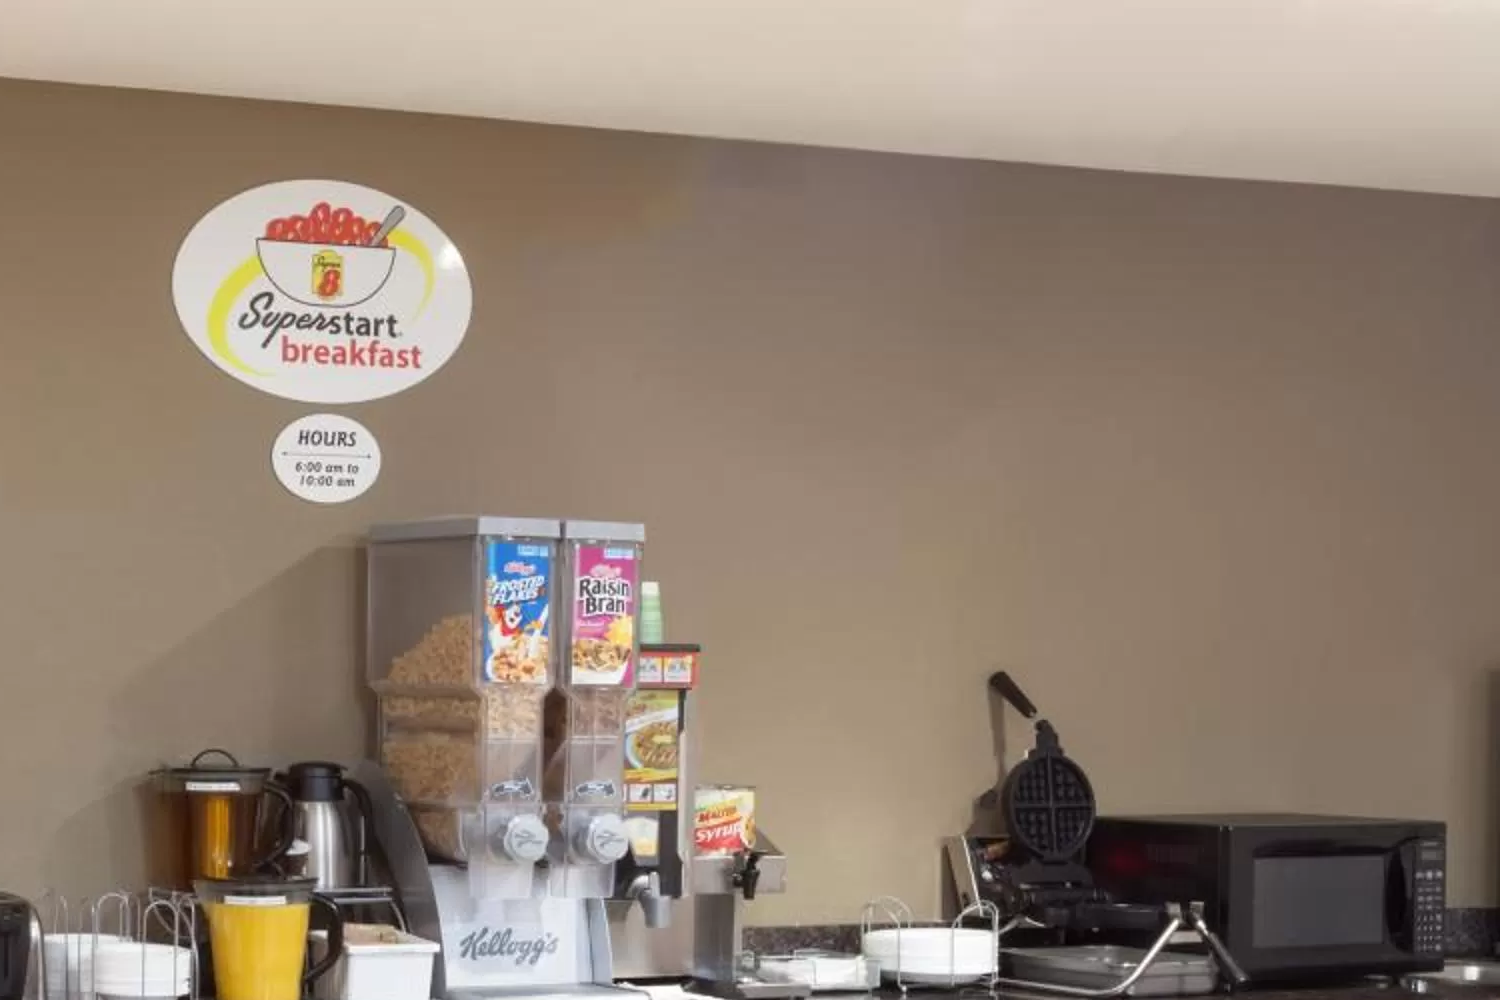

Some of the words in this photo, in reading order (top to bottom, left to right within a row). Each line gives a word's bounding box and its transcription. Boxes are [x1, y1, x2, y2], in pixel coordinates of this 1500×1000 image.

[318, 269, 341, 296] 8
[238, 291, 399, 349] Superstart
[281, 335, 422, 370] breakfast
[297, 429, 357, 447] HOURS
[295, 461, 322, 473] 6:00
[325, 464, 343, 473] am
[347, 463, 359, 474] to
[300, 475, 333, 487] 10:00
[579, 578, 631, 600] Raisin
[585, 597, 625, 614] Bran
[460, 926, 560, 966] Kellogg's
